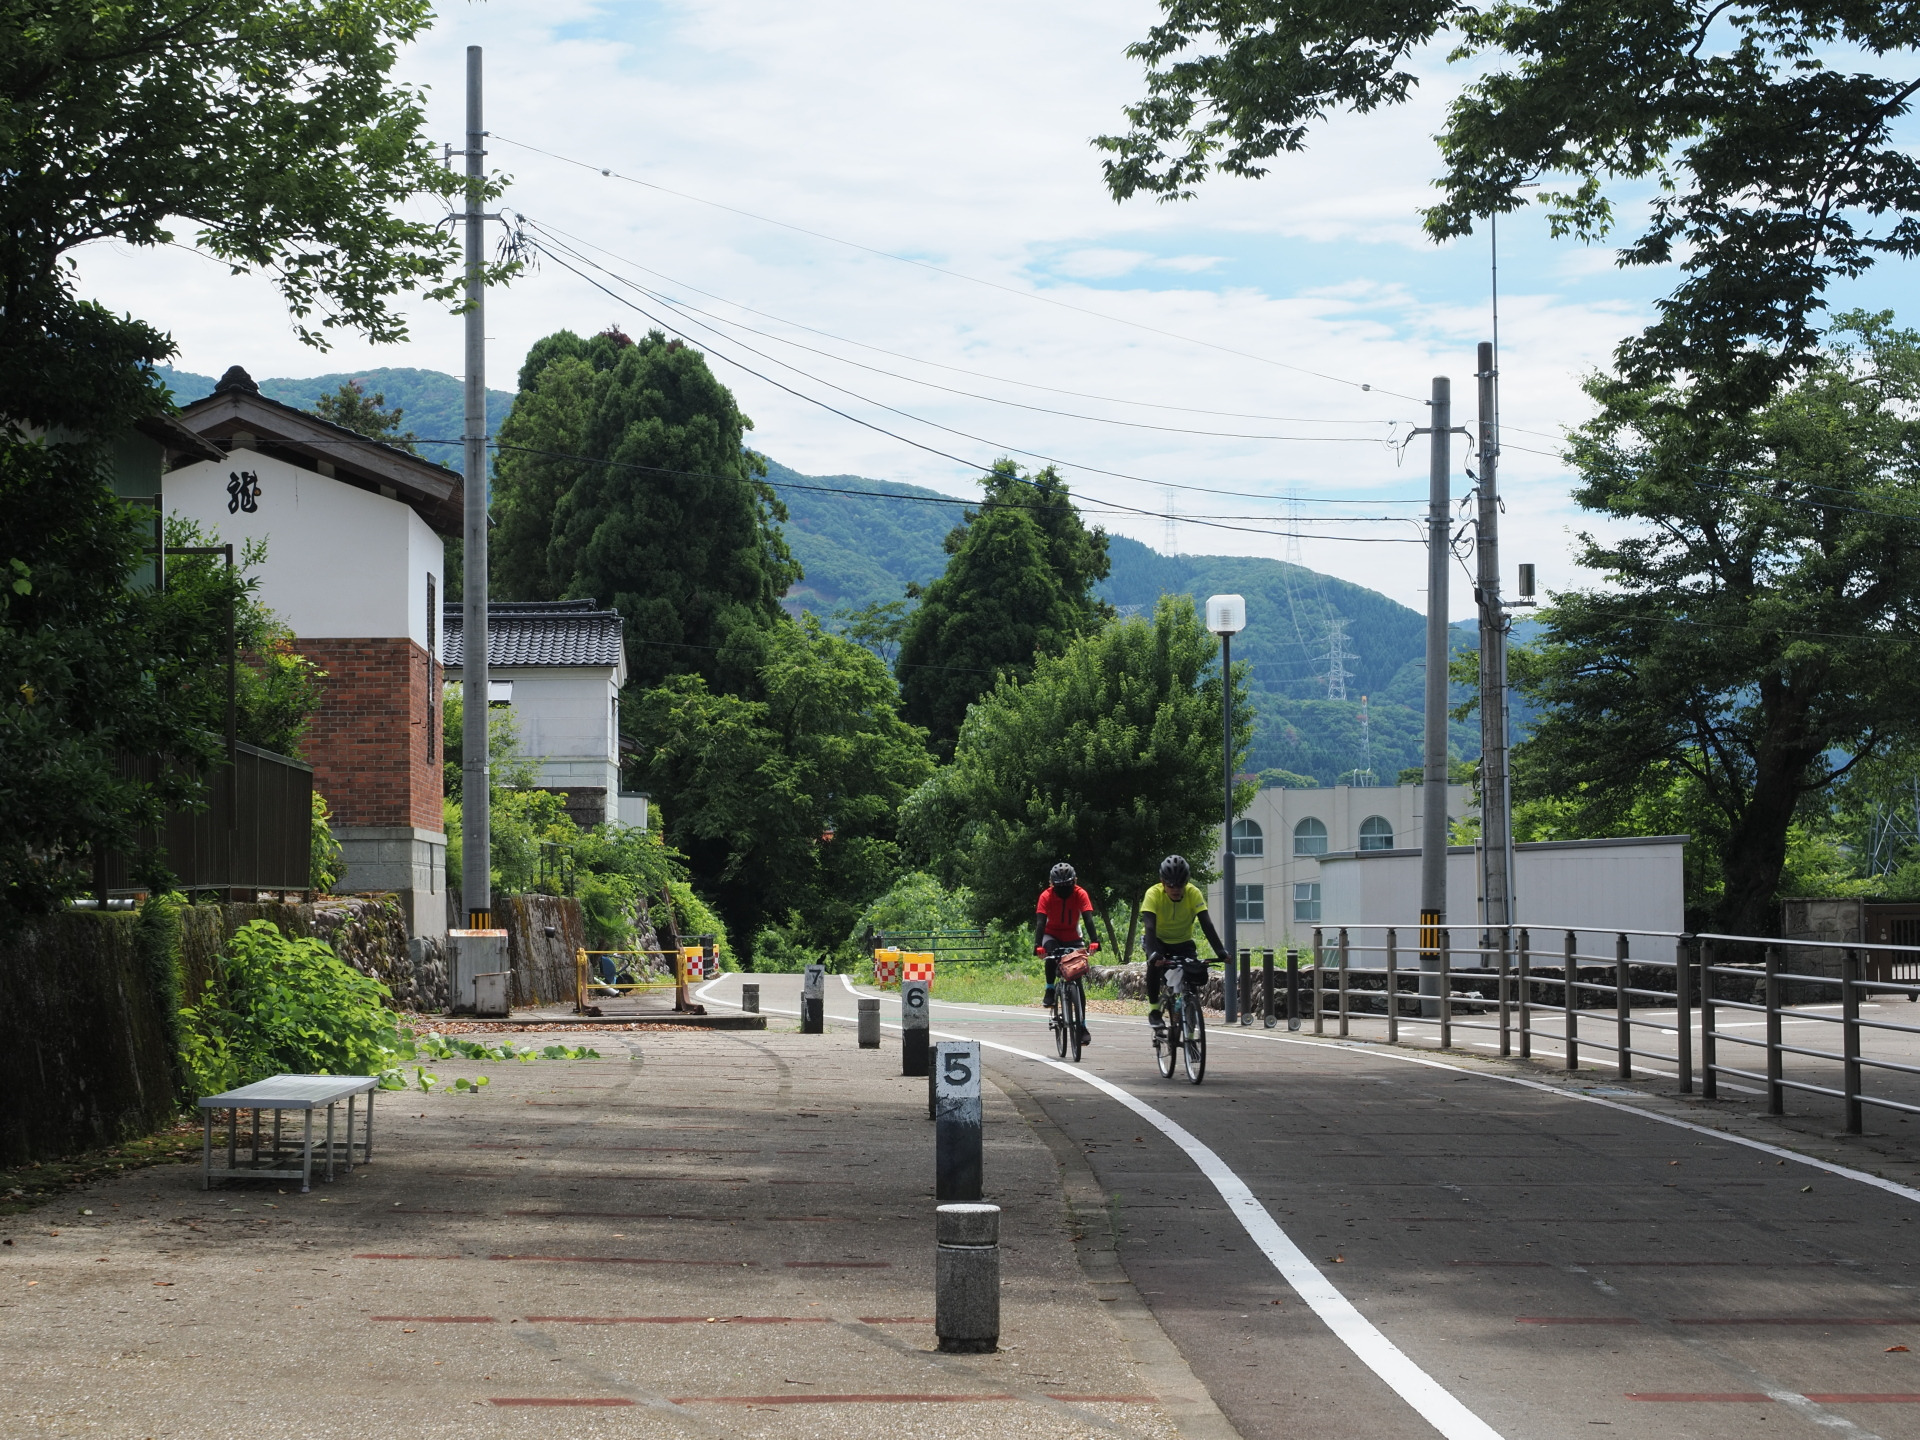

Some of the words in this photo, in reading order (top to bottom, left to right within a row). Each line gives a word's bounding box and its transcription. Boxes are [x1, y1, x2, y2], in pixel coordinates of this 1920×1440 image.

[808, 969, 822, 985] 7
[907, 987, 925, 1008] 6
[944, 1053, 972, 1086] 5
